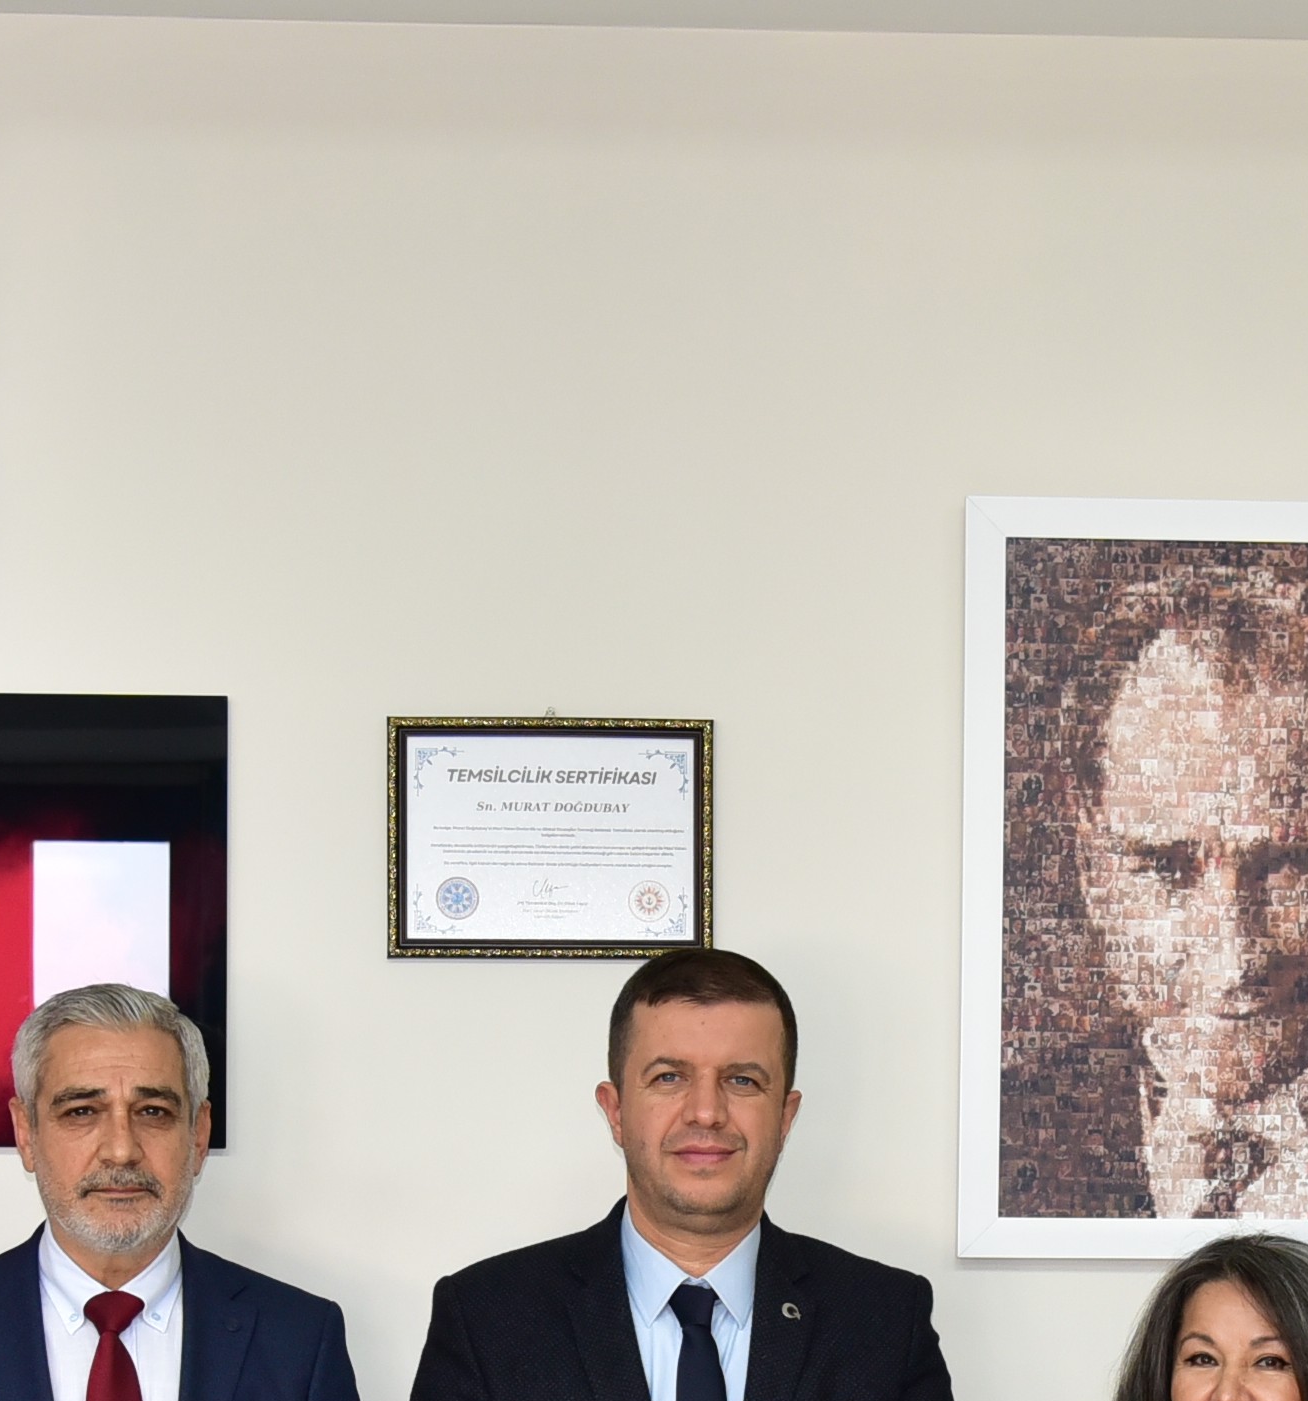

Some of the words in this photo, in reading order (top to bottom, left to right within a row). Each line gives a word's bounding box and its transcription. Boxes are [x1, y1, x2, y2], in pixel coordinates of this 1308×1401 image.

[447, 766, 553, 784] TEMSİLCİLİK
[555, 767, 657, 785] SERTİFİKASI
[476, 801, 497, 812] Sn.
[500, 801, 551, 813] MURAT
[554, 801, 631, 814] DOĞDUBAY
